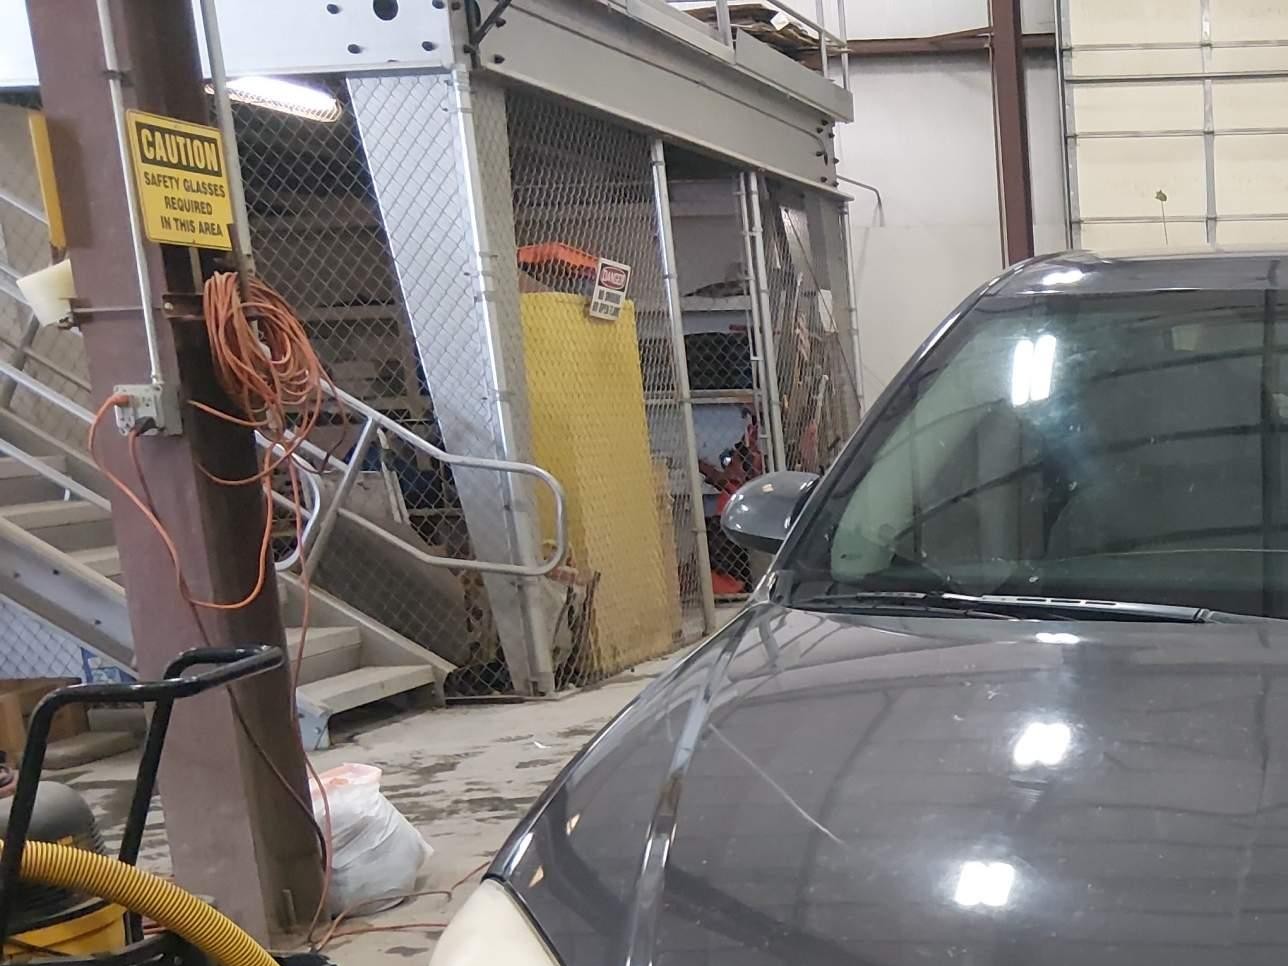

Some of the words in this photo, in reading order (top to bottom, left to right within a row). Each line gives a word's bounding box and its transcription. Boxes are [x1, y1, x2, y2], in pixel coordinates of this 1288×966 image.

[140, 127, 219, 172] CAUTION
[143, 171, 180, 191] SAFETY
[183, 178, 226, 199] GLASSES
[164, 195, 213, 216] REQUIRED
[160, 215, 172, 231] IN
[174, 217, 196, 234] THIS
[198, 220, 224, 238] AREA
